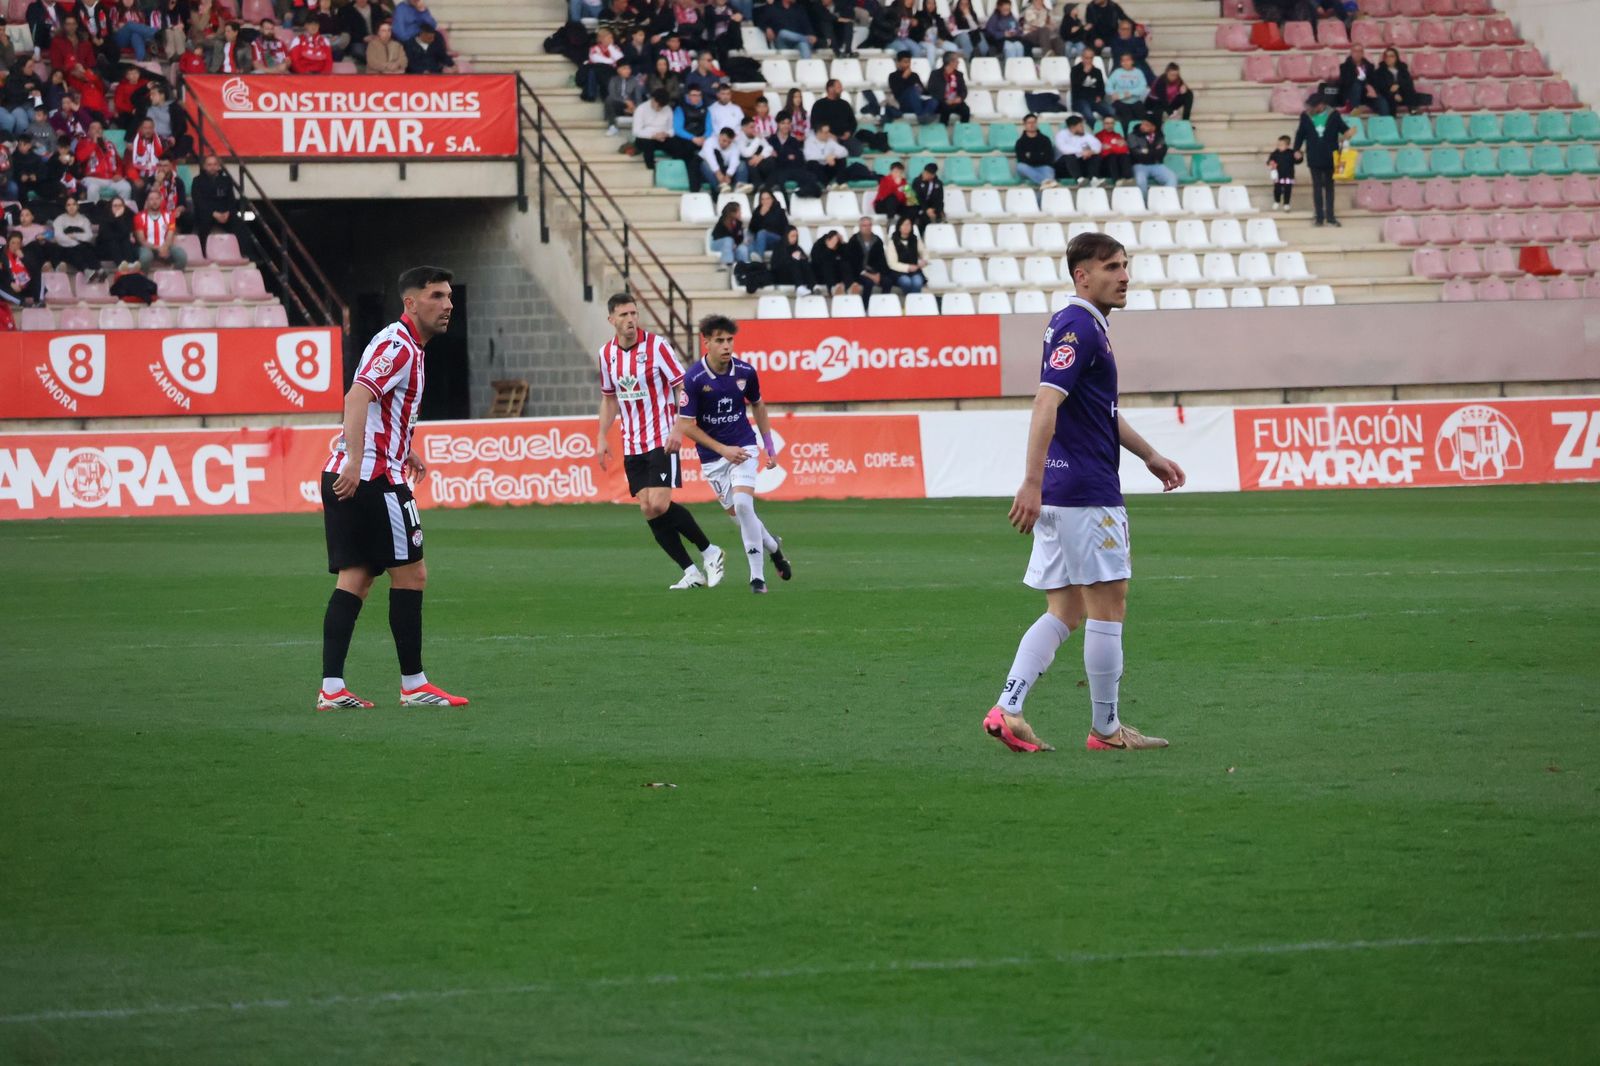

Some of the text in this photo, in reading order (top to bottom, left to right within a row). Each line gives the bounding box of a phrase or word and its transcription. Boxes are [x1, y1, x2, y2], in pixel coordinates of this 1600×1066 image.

[282, 116, 481, 154] TAMAR, S.A.
[68, 343, 94, 384] 8
[181, 341, 207, 382] 8
[295, 340, 320, 381] 8
[35, 363, 79, 412] ZAMORA
[149, 361, 191, 410] ZAMORA
[264, 359, 305, 408] ZAMORA
[424, 428, 596, 464] Escuela
[1253, 407, 1423, 448] FUNDACIÓN
[790, 443, 829, 458] COPE
[792, 459, 857, 474] ZAMORA
[864, 452, 915, 468] COPE.es
[191, 444, 271, 505] CF
[431, 465, 598, 503] infantil
